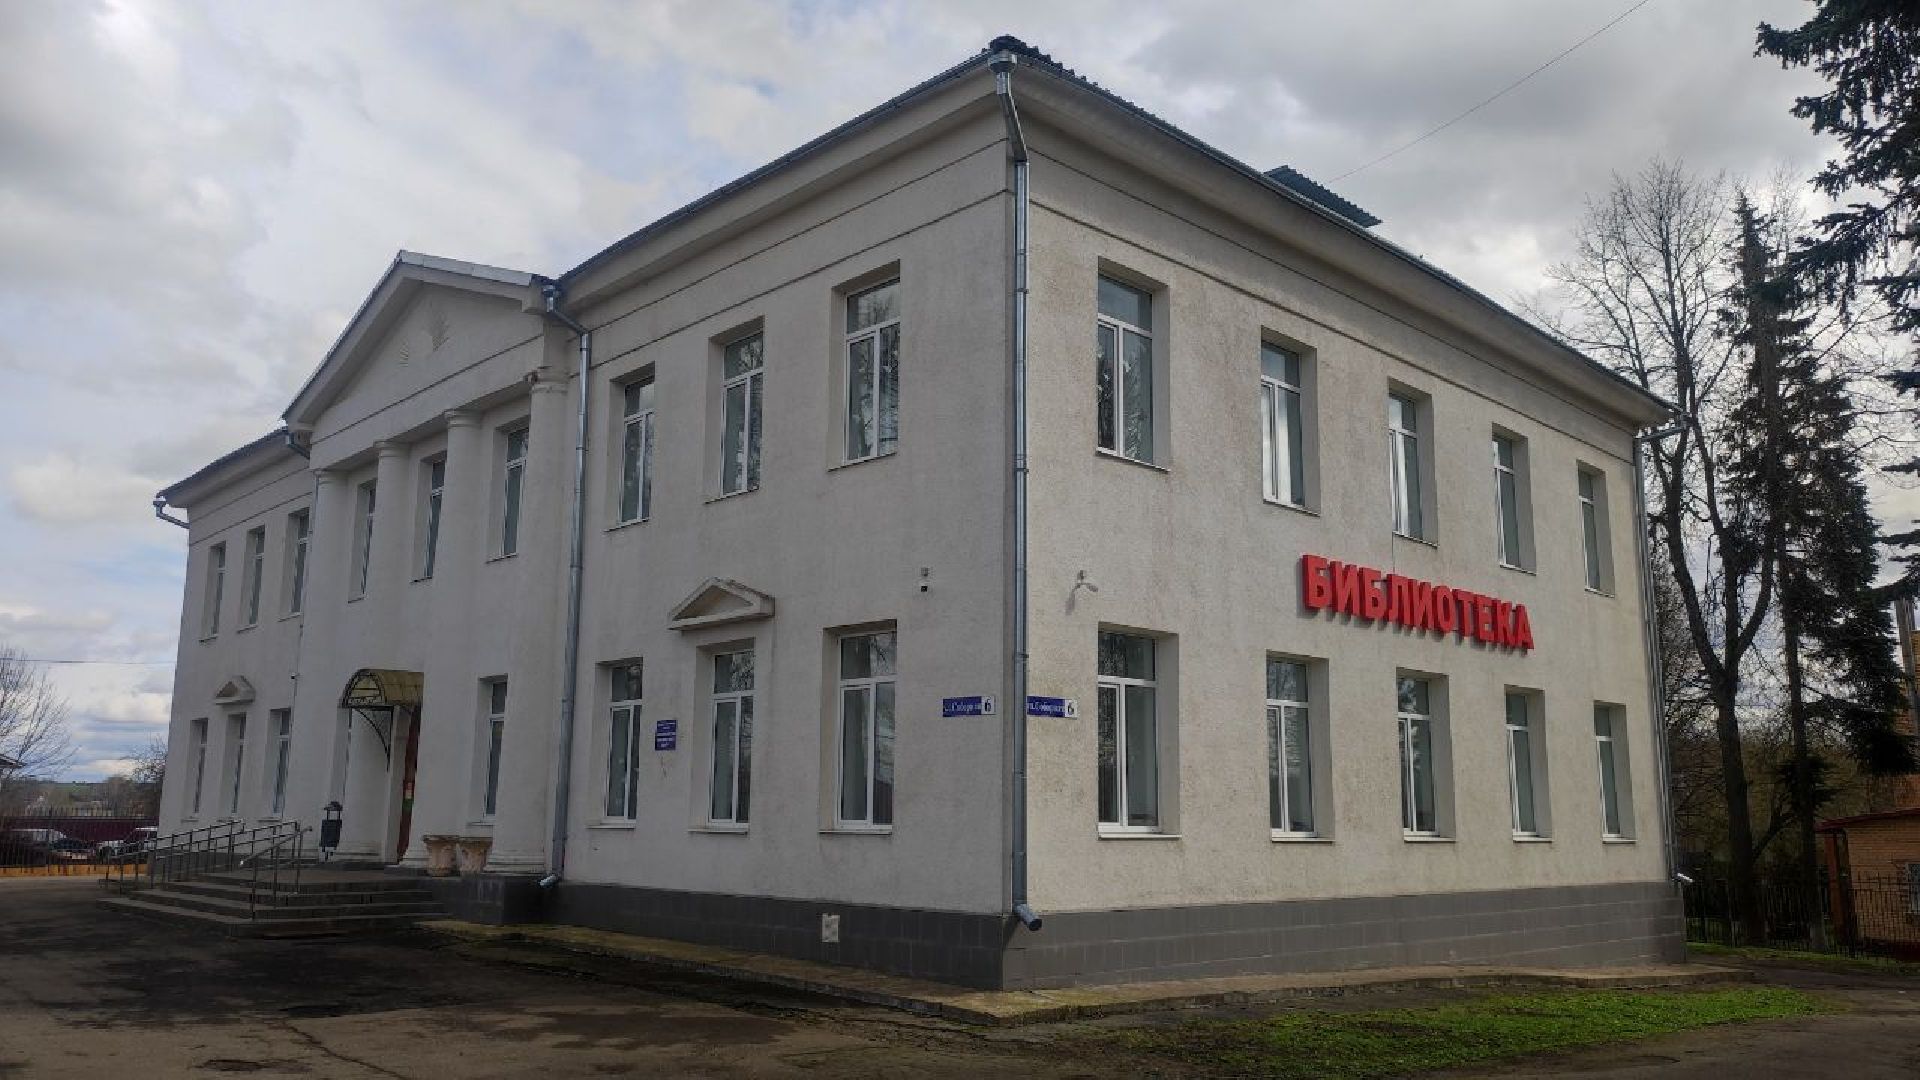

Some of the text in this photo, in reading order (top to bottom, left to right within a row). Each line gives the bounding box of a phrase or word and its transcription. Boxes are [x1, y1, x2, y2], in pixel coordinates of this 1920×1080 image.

[1303, 555, 1534, 650] БИБЛИОТЕКА
[984, 698, 992, 712] 6
[1067, 702, 1075, 716] 6
